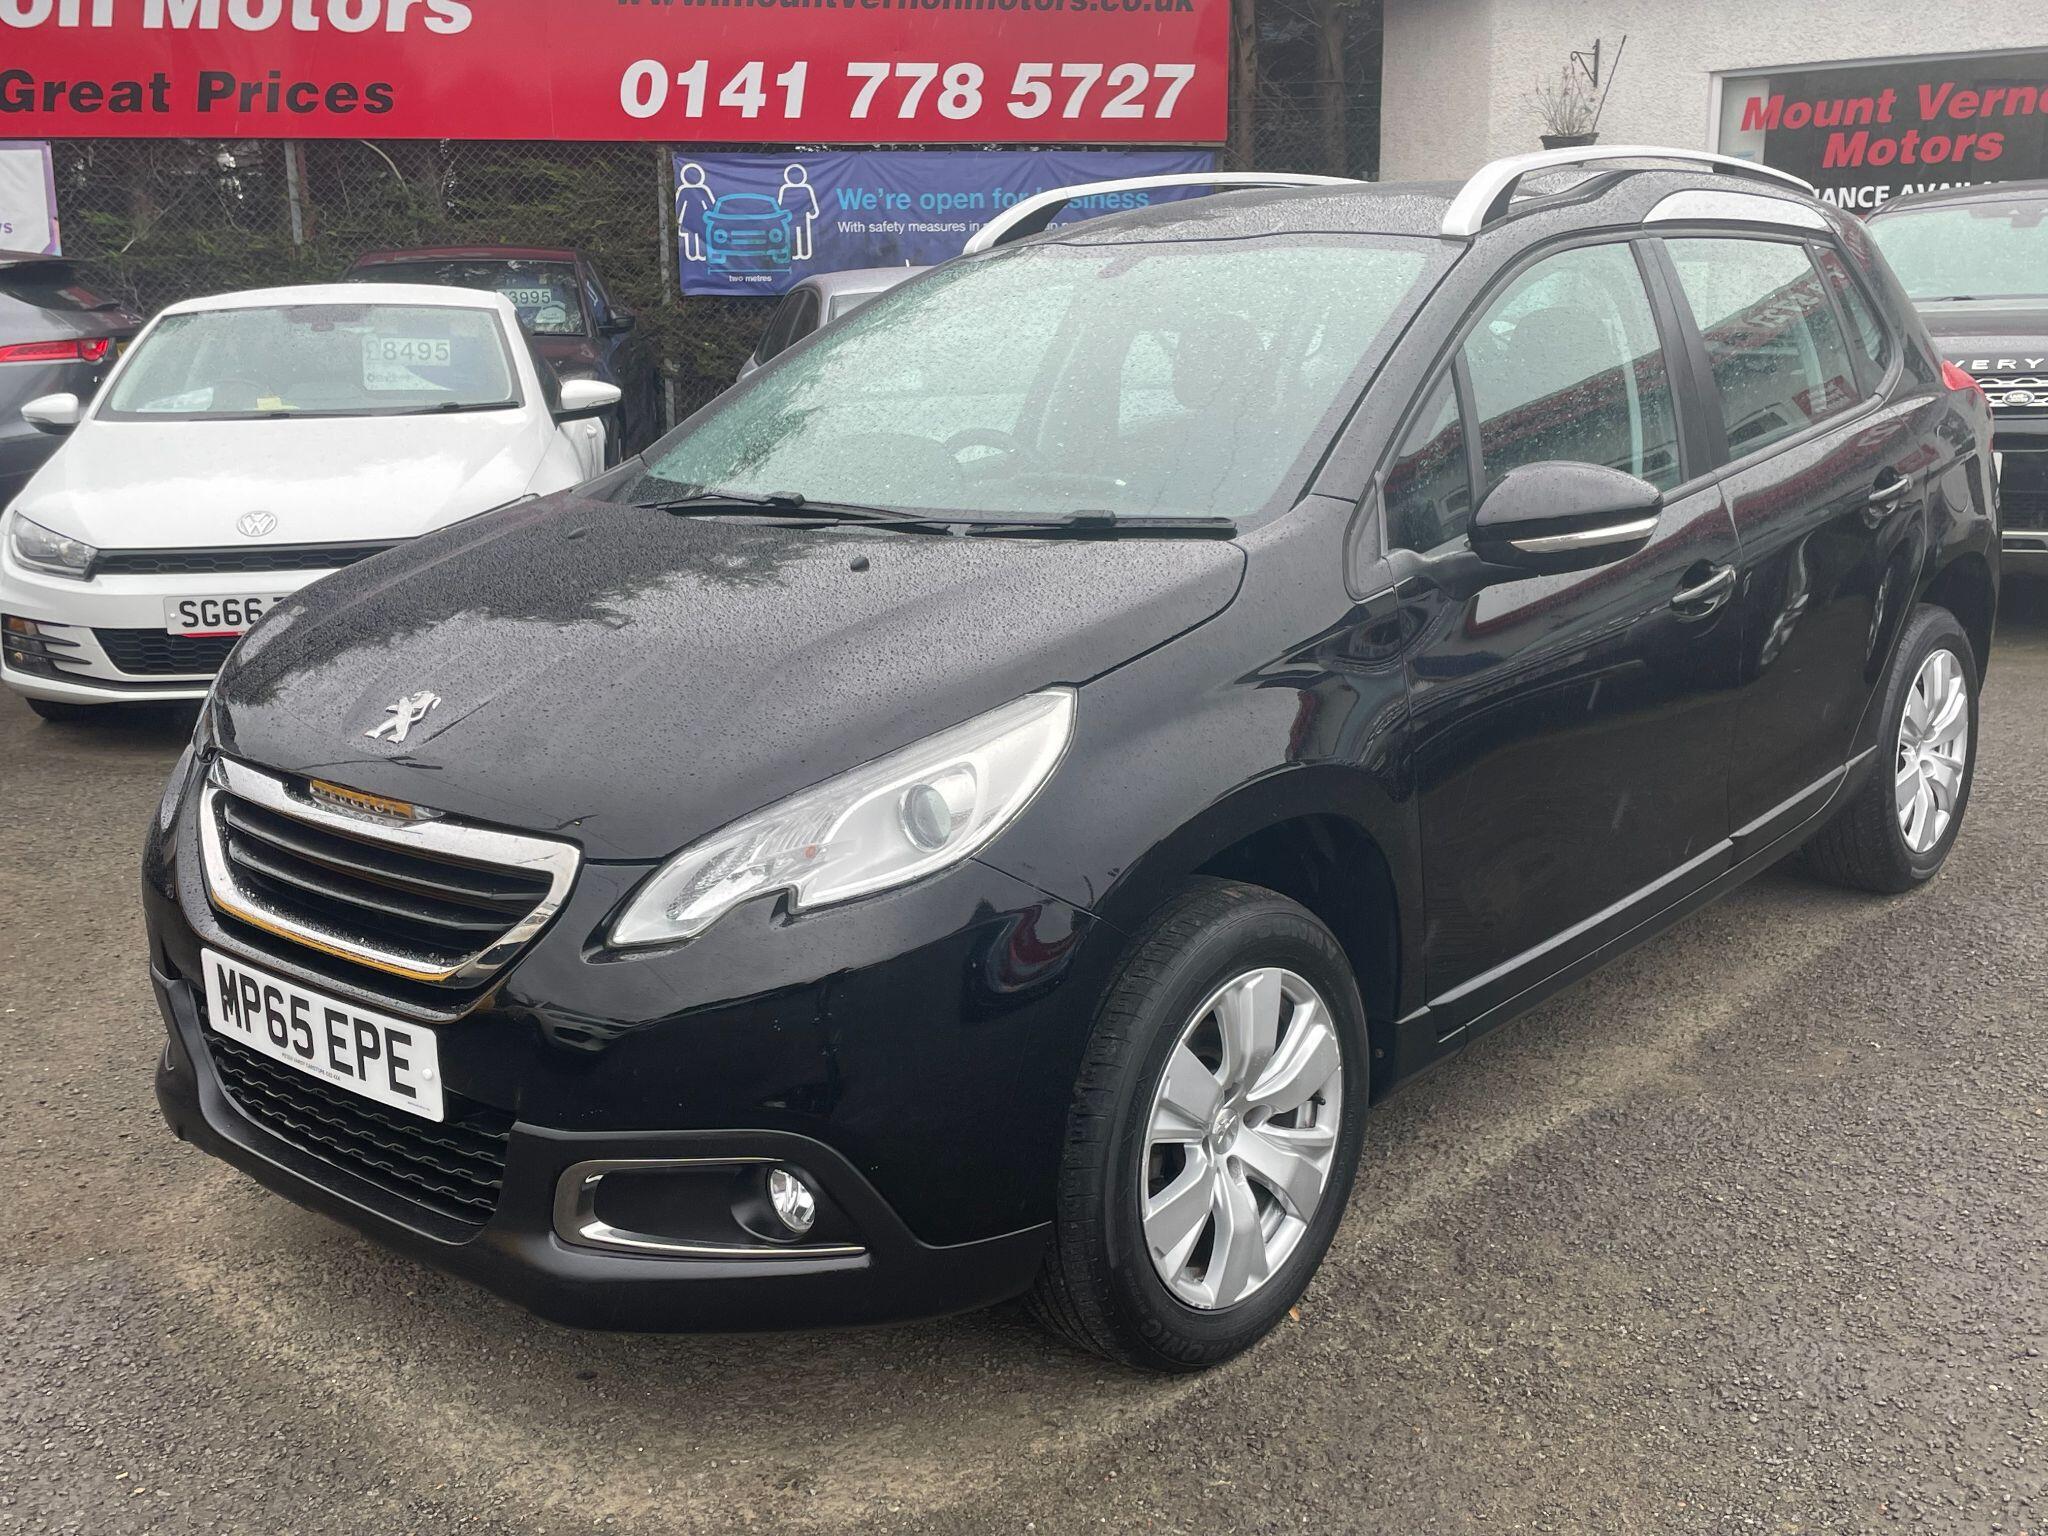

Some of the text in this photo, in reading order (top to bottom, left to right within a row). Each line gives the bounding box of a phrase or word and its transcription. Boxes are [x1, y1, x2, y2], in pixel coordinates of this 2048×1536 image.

[1, 69, 394, 114] Great Prices
[619, 58, 1197, 120] 0141 778 5727
[1740, 88, 1897, 131] Mount
[1822, 130, 2005, 168] Motors
[919, 192, 985, 214] open
[837, 220, 865, 233] With
[868, 220, 905, 235] safety
[908, 222, 965, 232] measures
[968, 220, 980, 231] in
[745, 274, 773, 283] metres
[503, 291, 551, 304] 3995
[179, 597, 263, 628] SG66
[216, 963, 417, 1099] MP65 EPE
